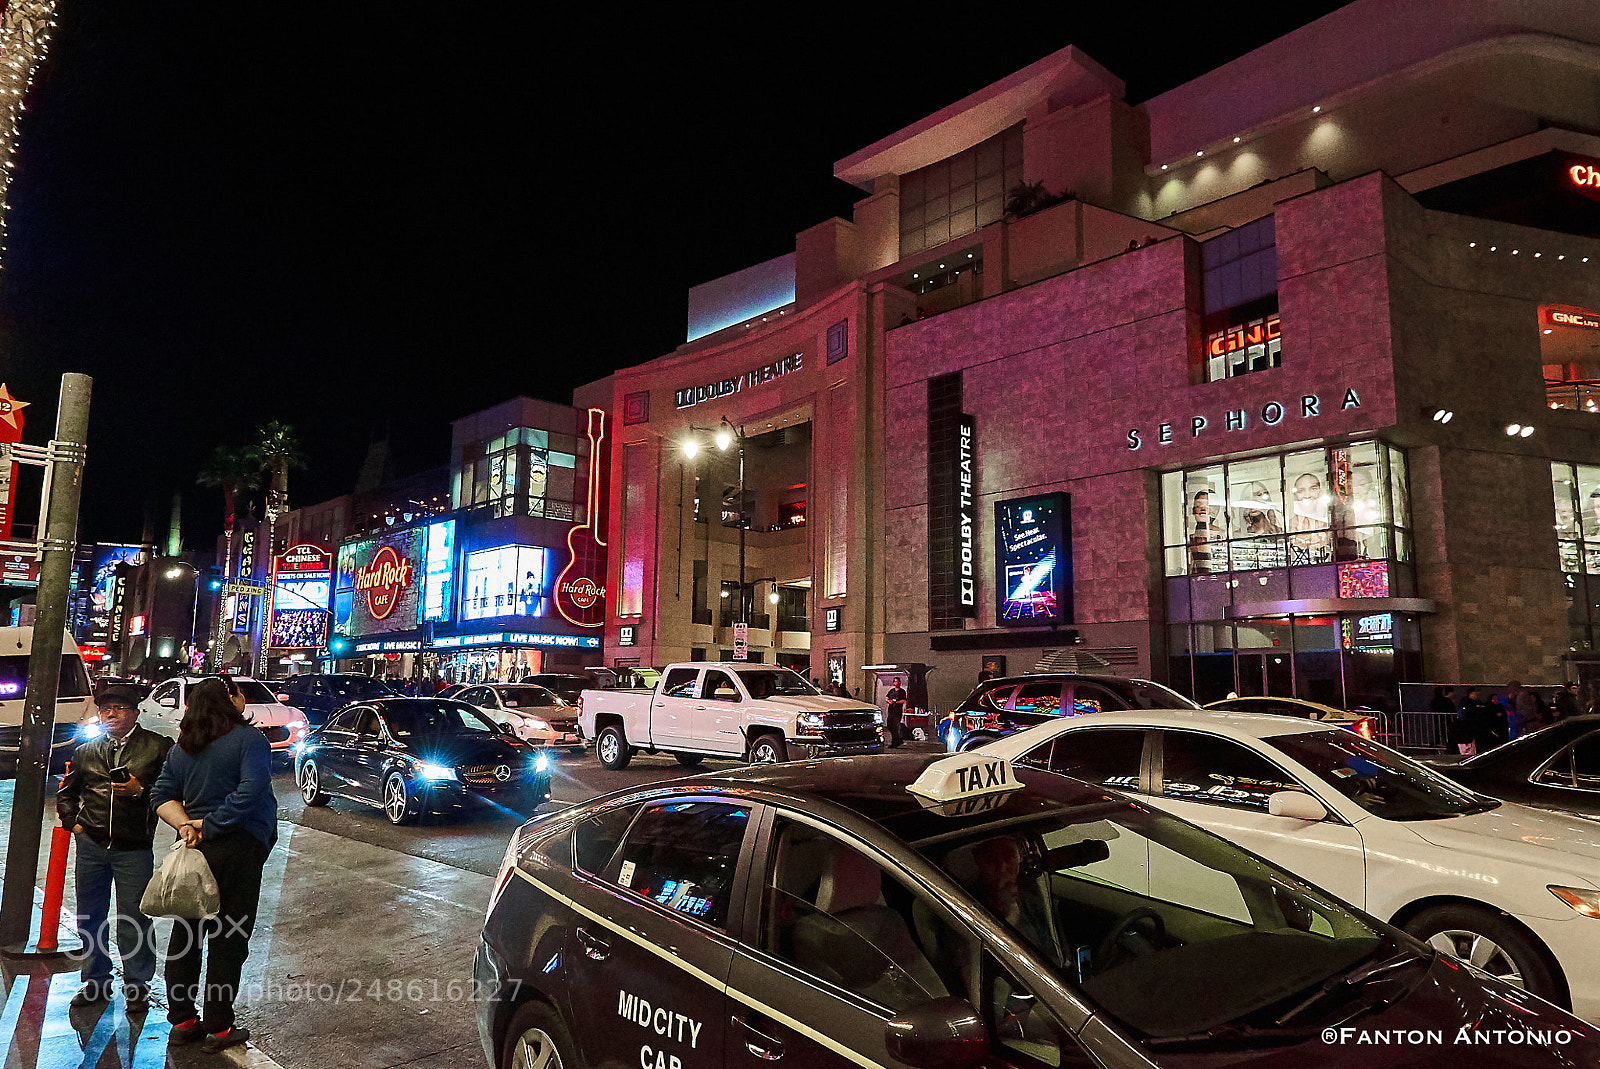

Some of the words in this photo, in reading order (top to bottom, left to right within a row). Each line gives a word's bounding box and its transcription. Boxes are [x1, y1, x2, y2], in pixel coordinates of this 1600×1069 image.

[1552, 312, 1584, 325] GNC
[1211, 319, 1281, 355] GNC
[697, 375, 743, 403] DOLBY
[744, 352, 803, 389] THEATRE
[1127, 387, 1361, 451] SEPHORA
[960, 424, 972, 508] THEATRE
[286, 555, 321, 563] CHINESE
[297, 547, 312, 555] TCL
[960, 512, 973, 577] DOLBY
[231, 585, 244, 593] PED
[357, 563, 383, 590] Hard
[382, 558, 408, 590] Rock
[375, 595, 389, 606] CAFE
[562, 582, 585, 594] Hard
[585, 584, 606, 598] Rock
[113, 577, 126, 641] CHINESE
[510, 633, 527, 643] LIVE
[528, 634, 555, 645] MUSIC
[956, 761, 1006, 792] TAXI
[618, 989, 702, 1049] MIDCITY
